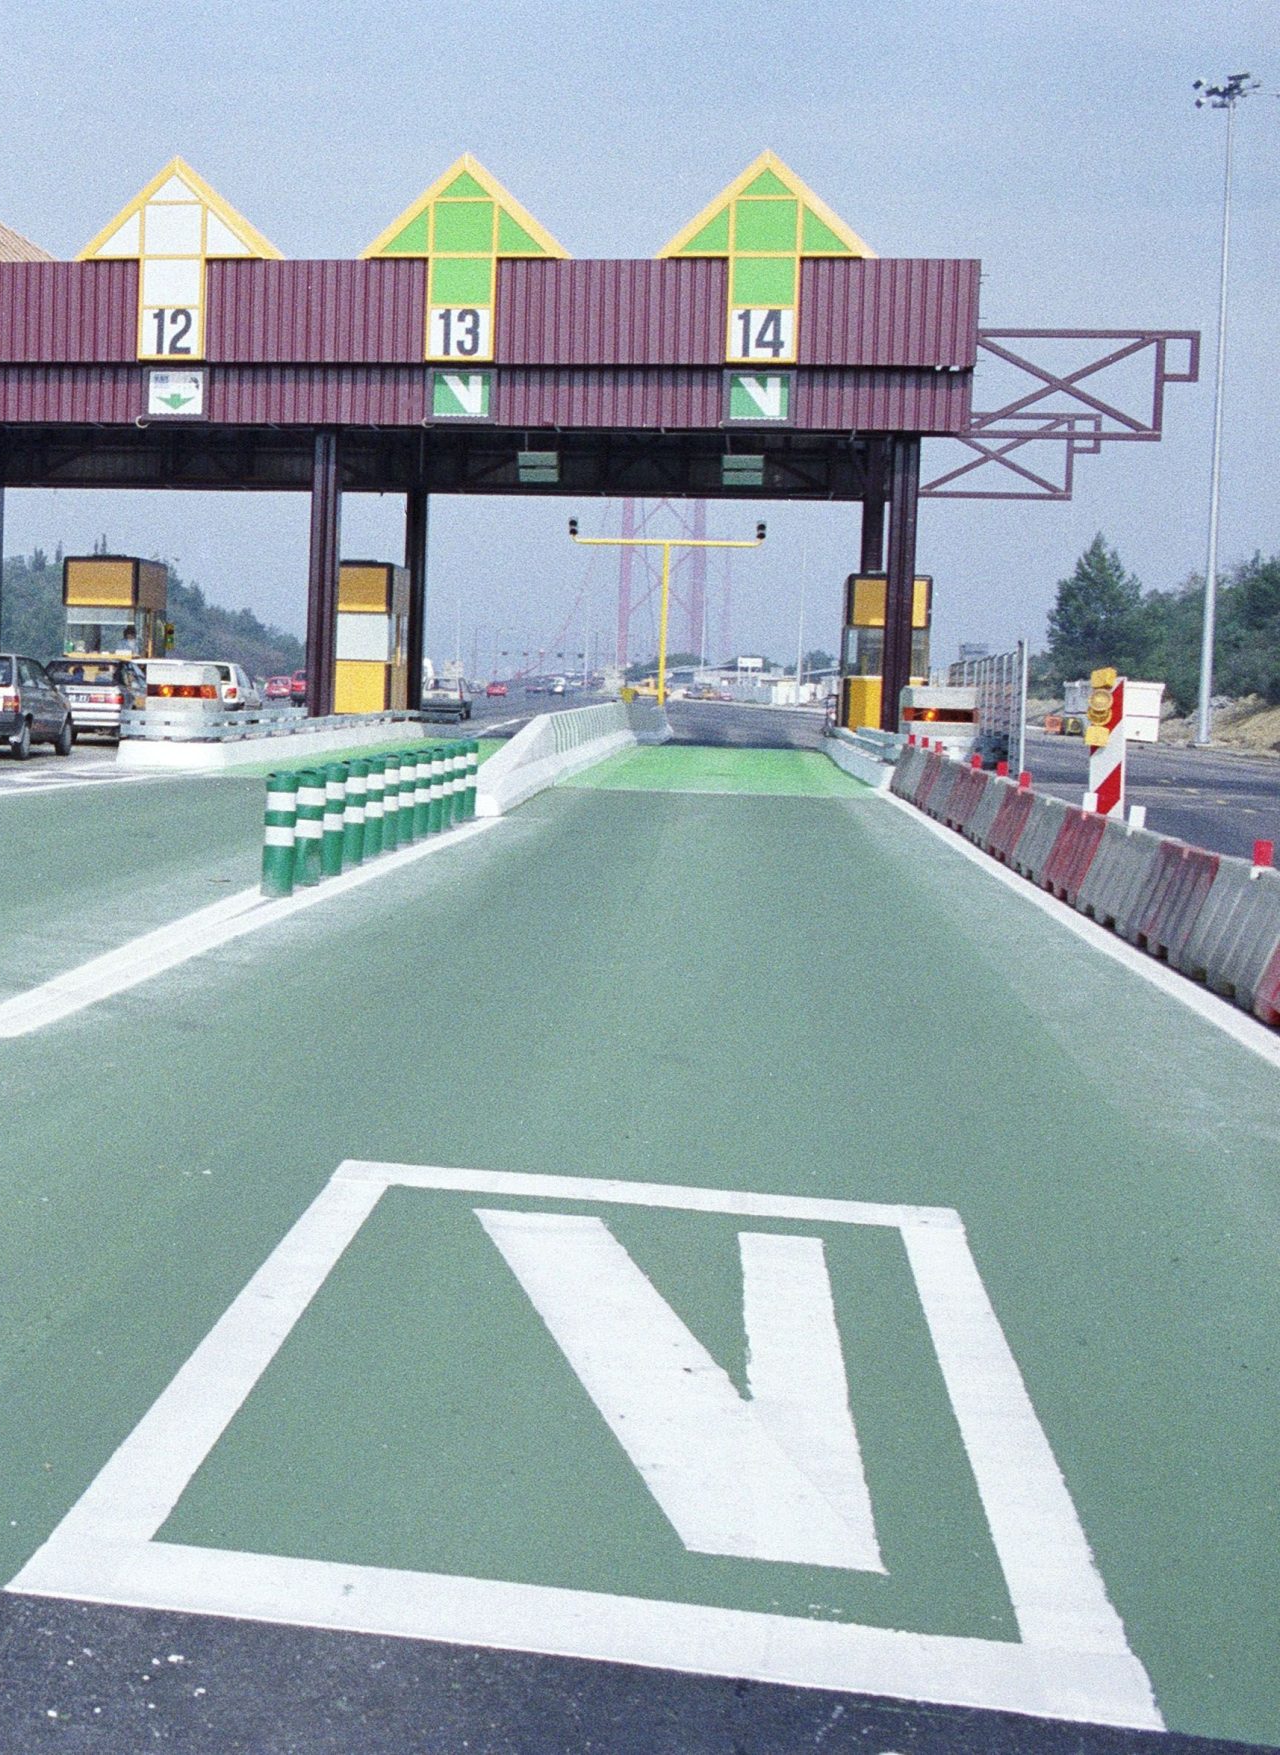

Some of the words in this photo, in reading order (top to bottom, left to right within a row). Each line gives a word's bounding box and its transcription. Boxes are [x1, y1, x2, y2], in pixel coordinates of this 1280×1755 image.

[152, 308, 193, 355] 12
[438, 308, 480, 357] 13
[737, 308, 785, 358] 14
